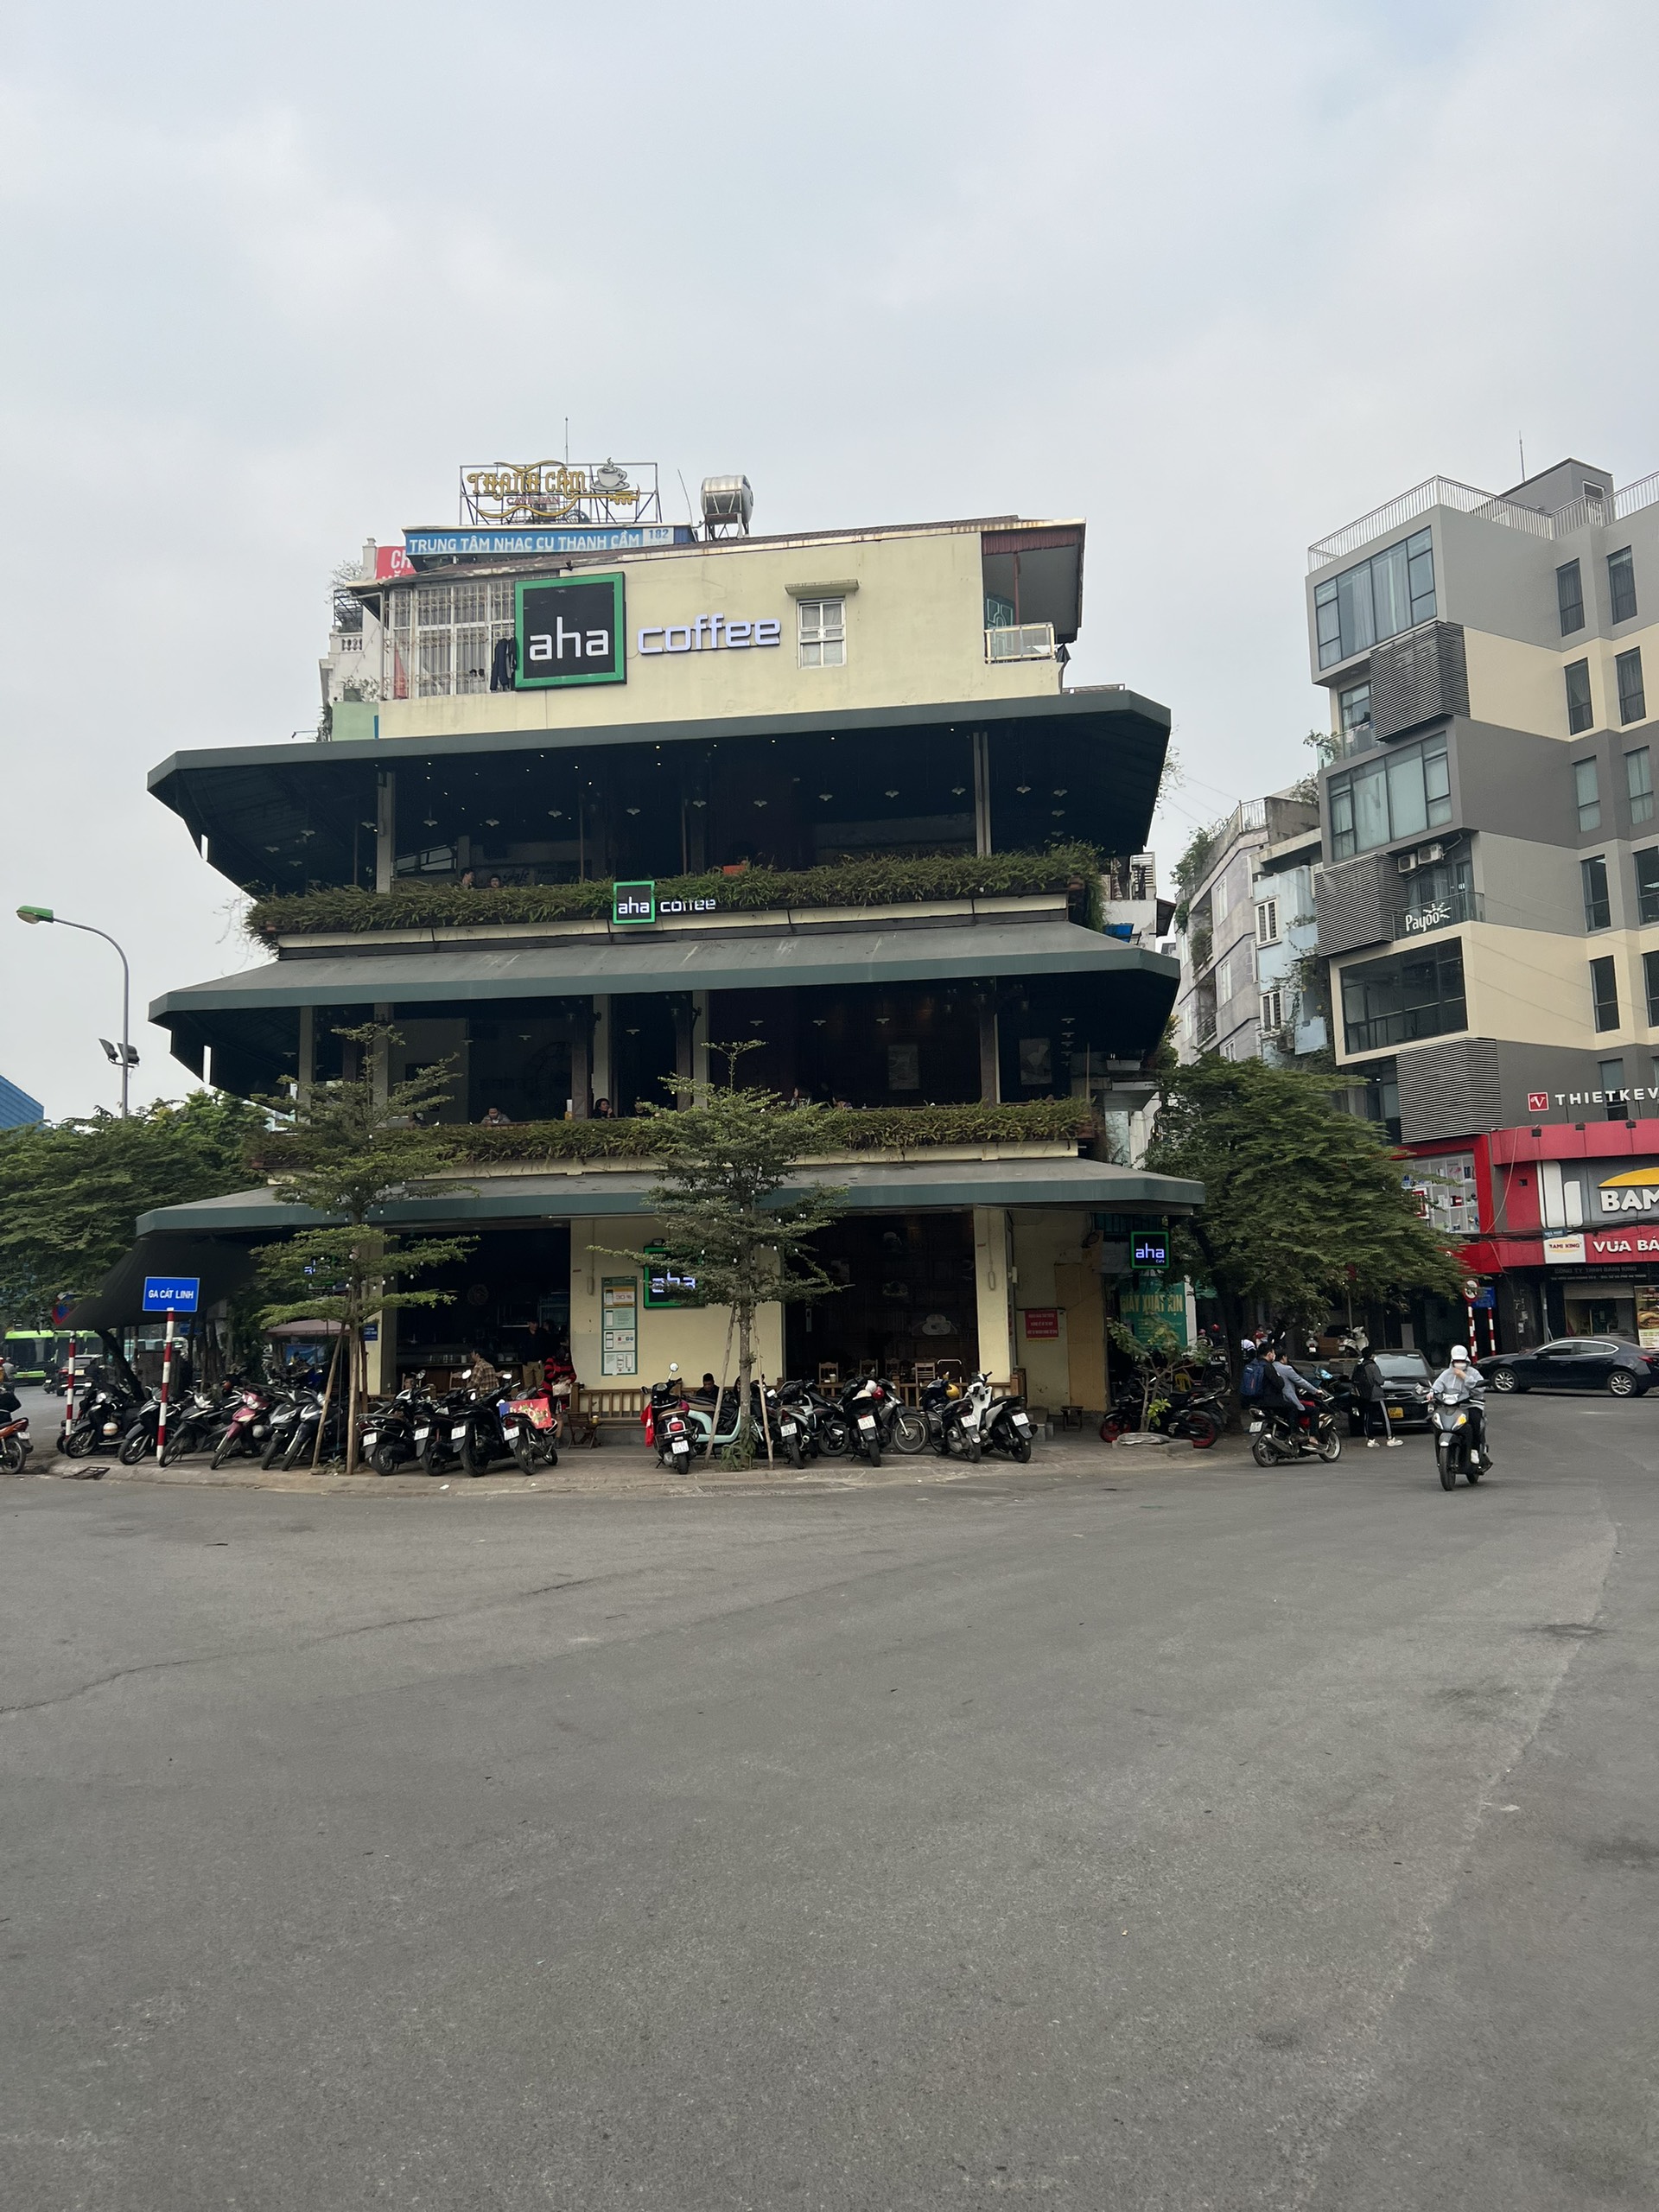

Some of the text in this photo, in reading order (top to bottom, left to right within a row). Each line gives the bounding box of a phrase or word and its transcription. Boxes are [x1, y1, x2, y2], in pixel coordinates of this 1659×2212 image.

[410, 538, 456, 552] TRUNG
[461, 535, 490, 551] TÂM
[559, 535, 607, 550] THANH
[611, 530, 639, 548] CẦM
[648, 528, 670, 539] 182
[529, 613, 781, 661] aha coffee
[618, 896, 650, 914] aha
[1405, 912, 1440, 932] Payoo
[1555, 1087, 1659, 1106] THIETKEV
[1135, 1243, 1165, 1258] aha
[1593, 1240, 1632, 1253] VUA
[148, 1287, 194, 1300] GA CÁT LINH
